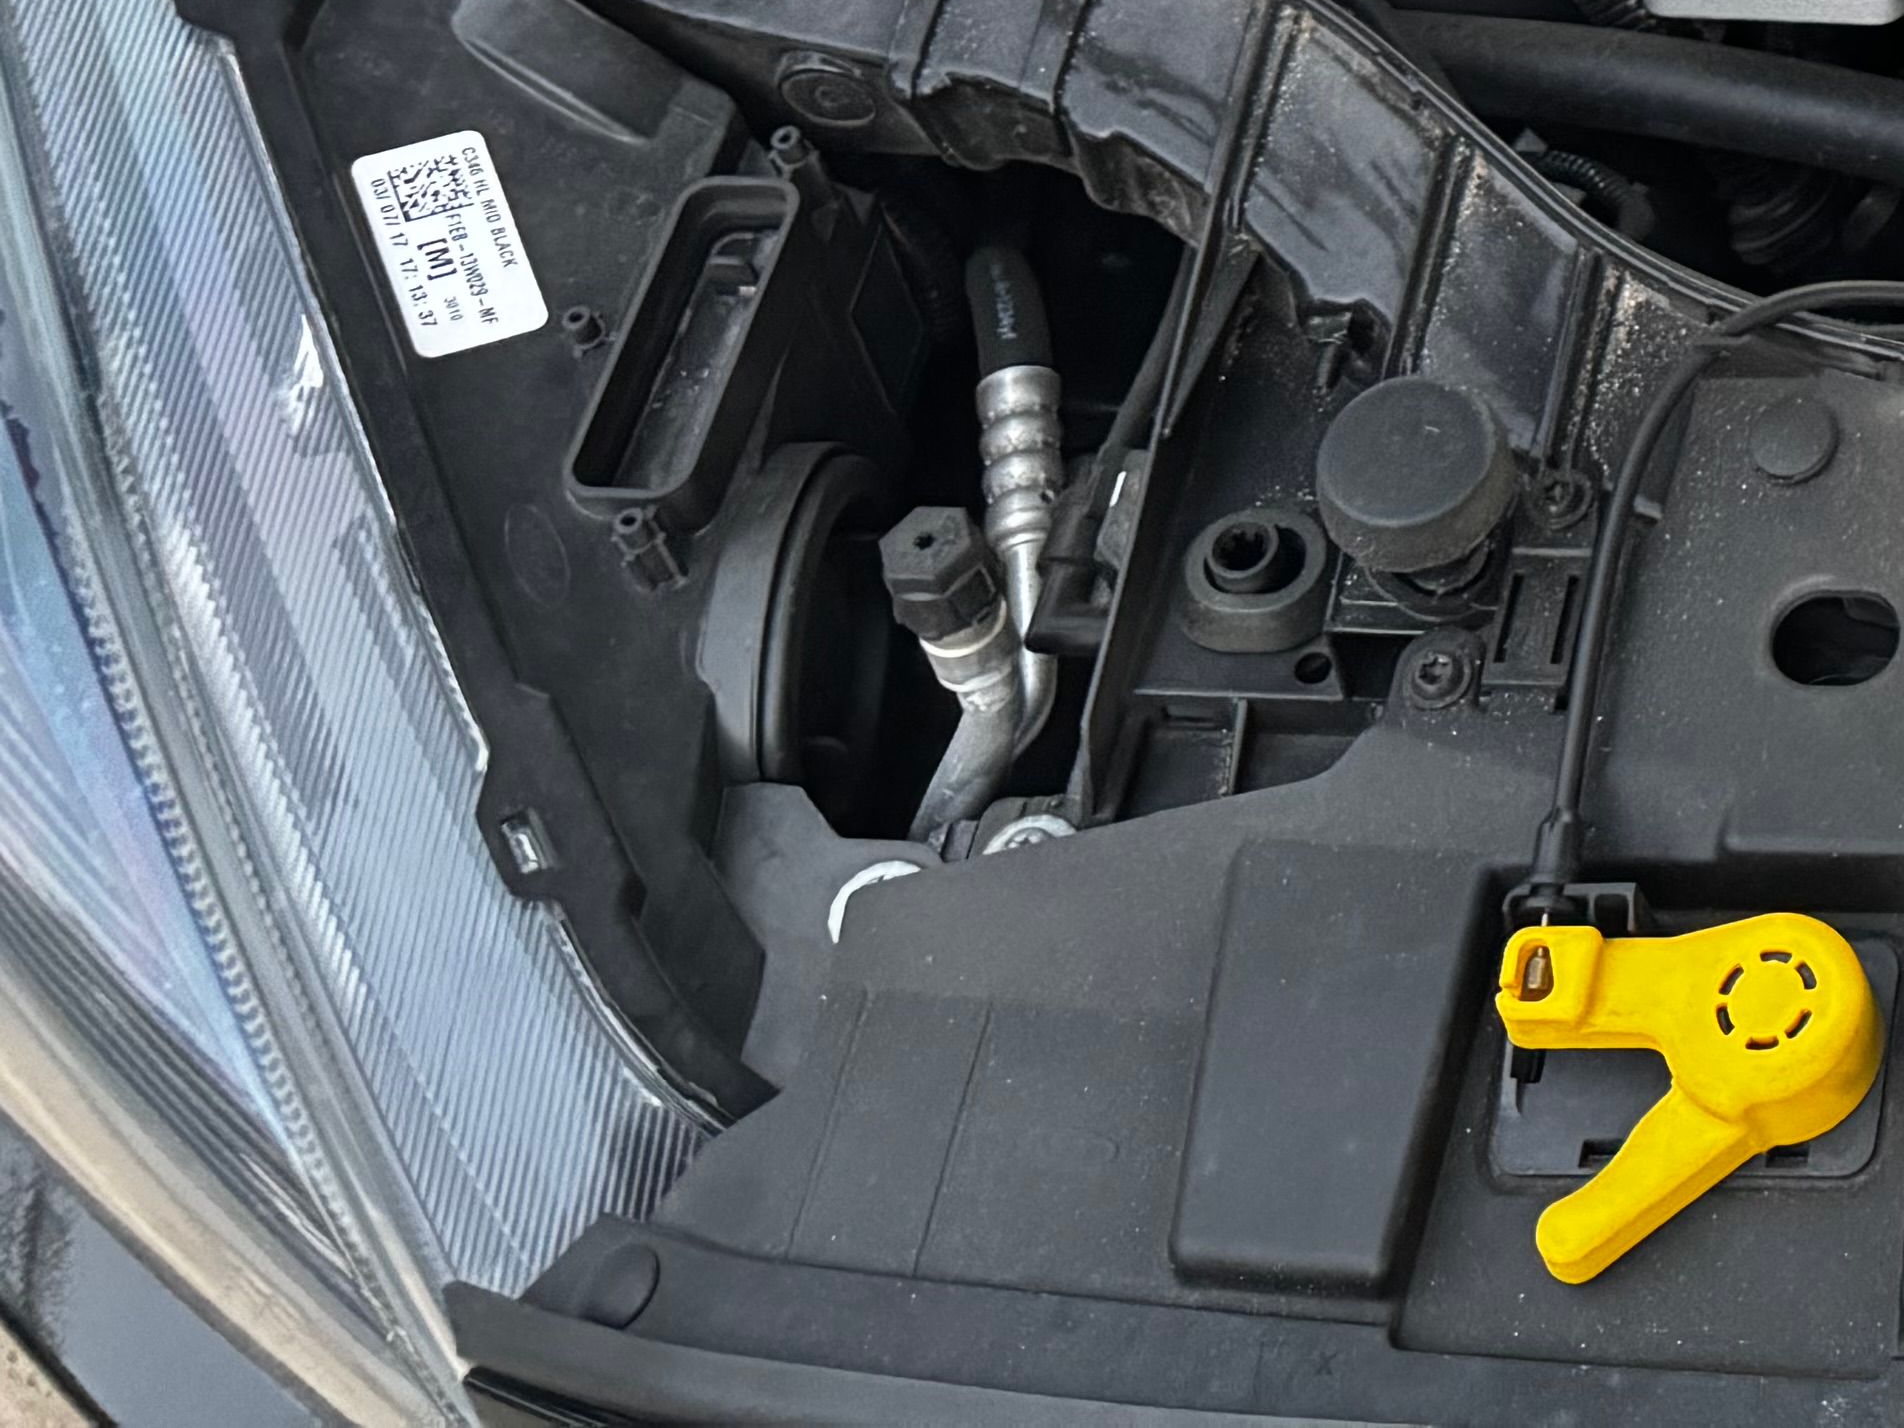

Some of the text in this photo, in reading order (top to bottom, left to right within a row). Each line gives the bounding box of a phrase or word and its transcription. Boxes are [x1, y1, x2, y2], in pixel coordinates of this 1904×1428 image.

[475, 179, 491, 197] HL
[481, 199, 502, 224] MID
[490, 226, 519, 268] BLACK
